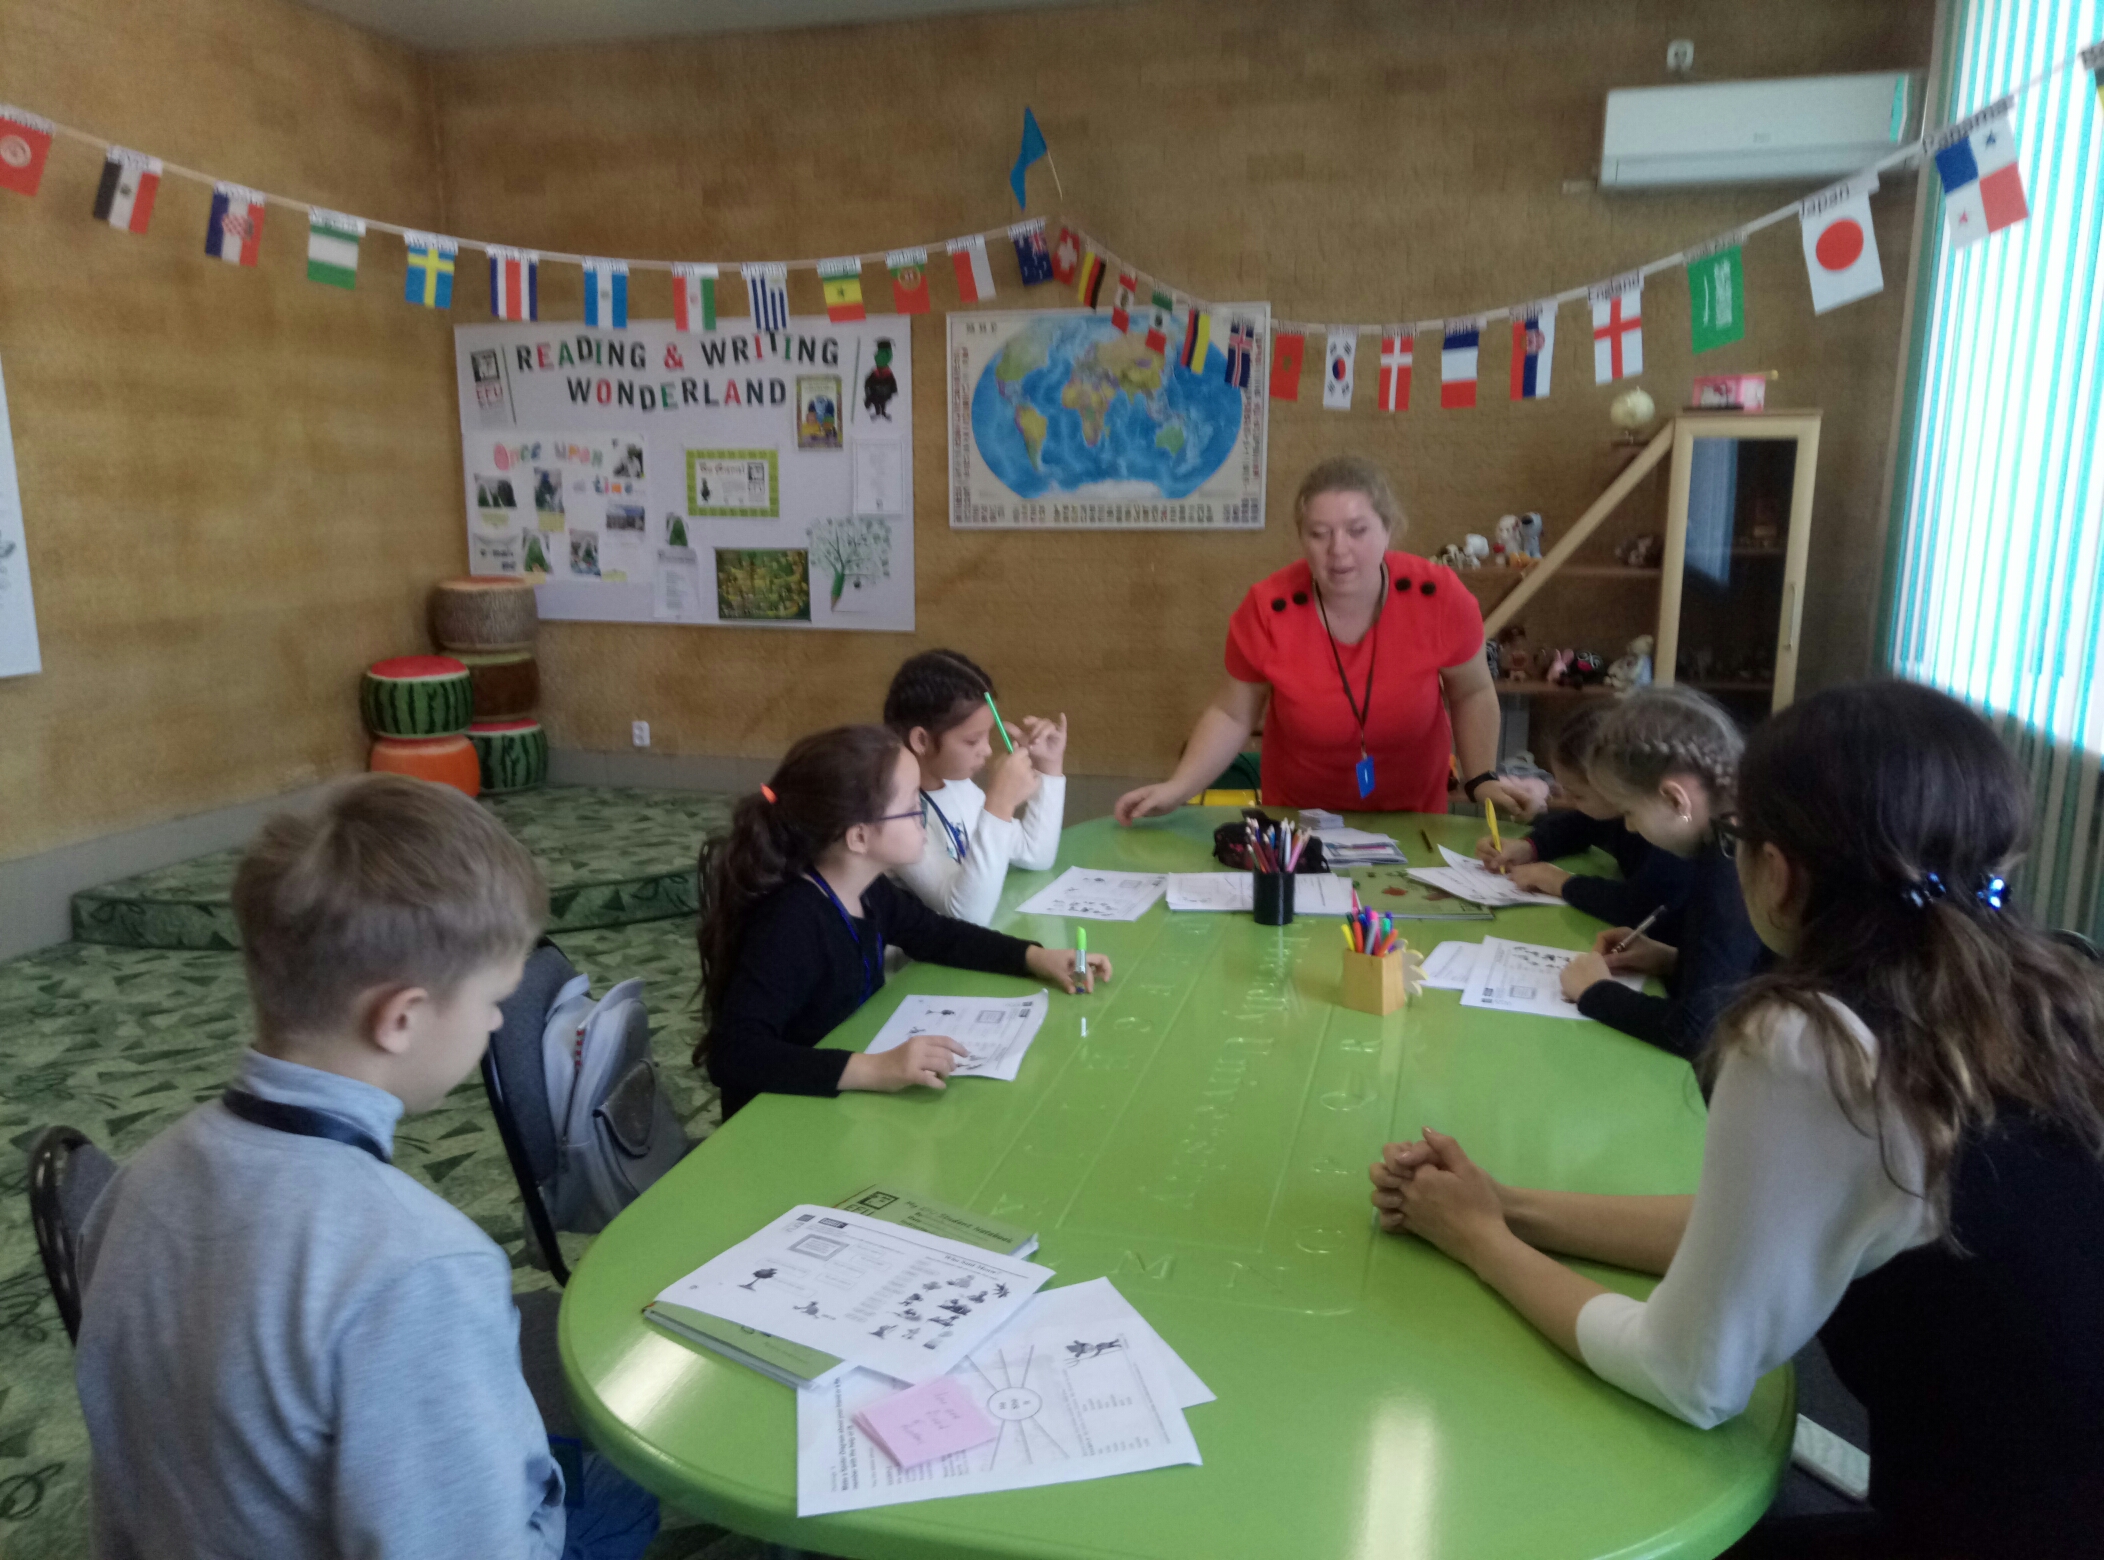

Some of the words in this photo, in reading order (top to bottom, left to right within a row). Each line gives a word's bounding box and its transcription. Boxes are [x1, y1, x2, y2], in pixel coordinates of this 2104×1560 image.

[1922, 98, 2009, 154] Panama
[1801, 183, 1850, 218] Japan
[1587, 268, 1640, 302] England
[515, 334, 647, 373] READING
[663, 342, 684, 371] &
[700, 331, 840, 369] WRITING
[566, 375, 787, 411] WONDERLAND
[941, 1213, 973, 1228] Student
[974, 1226, 1013, 1243] Notebook
[1107, 1250, 1175, 1280] M
